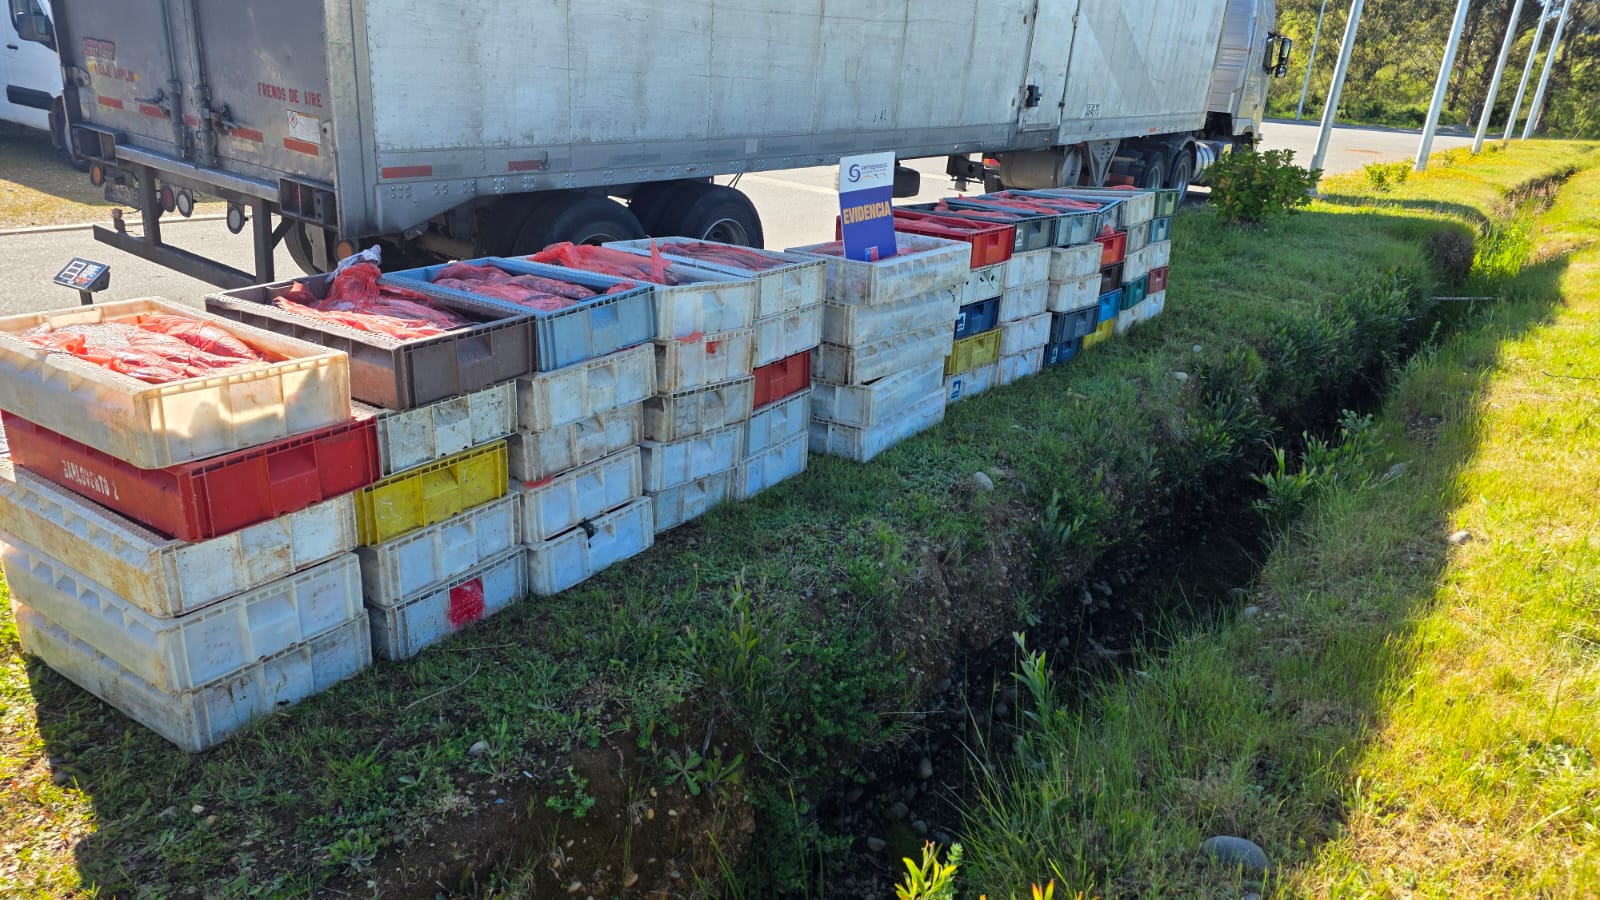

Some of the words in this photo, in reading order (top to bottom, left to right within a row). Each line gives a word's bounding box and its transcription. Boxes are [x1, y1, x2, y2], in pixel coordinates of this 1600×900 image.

[257, 82, 286, 101] FRENOS
[288, 88, 299, 103] DE
[304, 91, 323, 108] AIRE
[843, 201, 891, 224] EVIDENCIA
